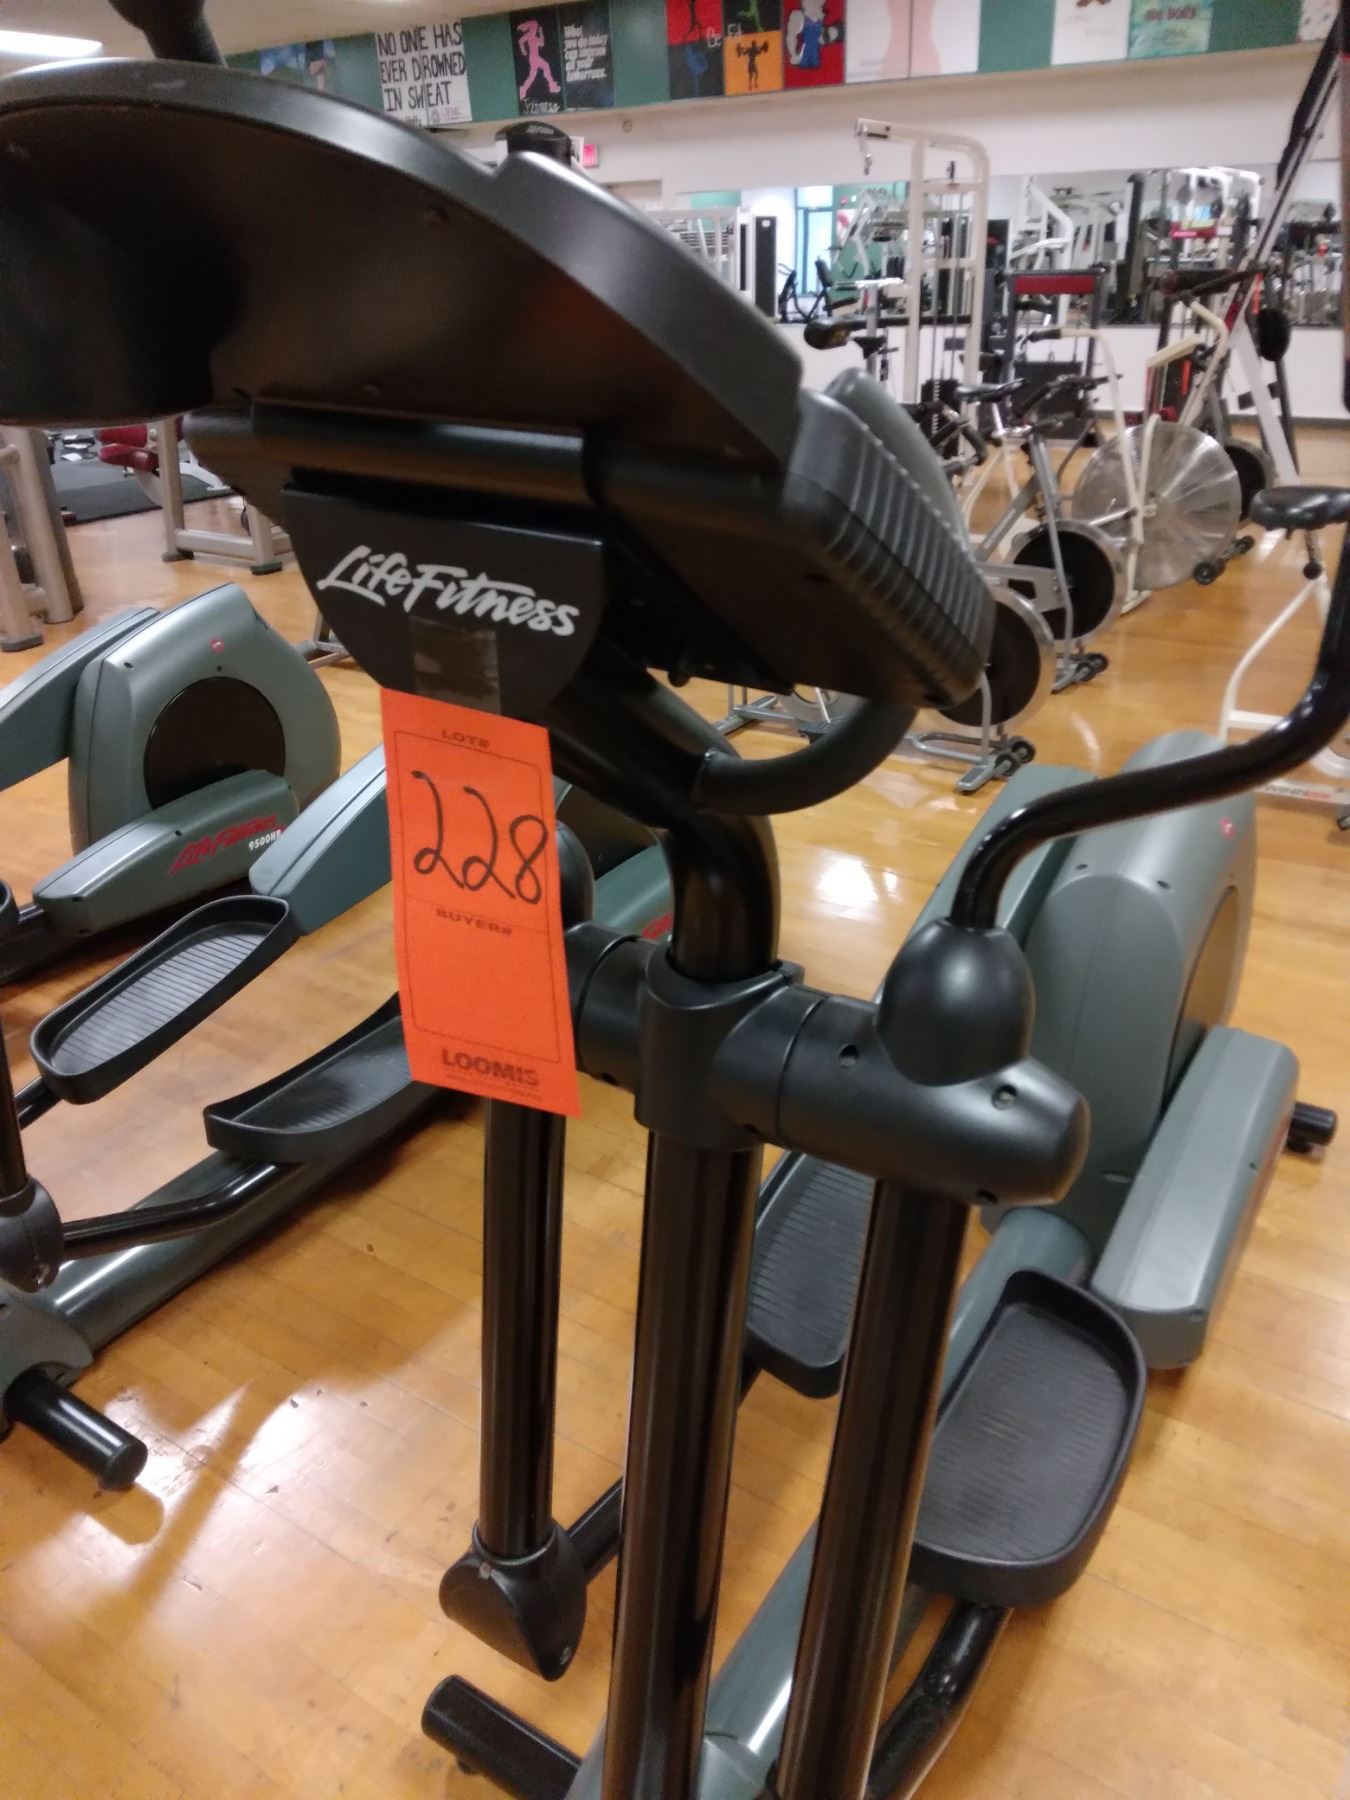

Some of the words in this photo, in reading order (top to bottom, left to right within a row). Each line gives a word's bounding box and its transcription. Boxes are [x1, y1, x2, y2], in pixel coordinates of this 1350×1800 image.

[377, 32, 397, 56] NO
[400, 25, 429, 54] ONE
[433, 22, 463, 48] HAS
[380, 59, 407, 84] EVER
[412, 51, 466, 81] DROWNED
[384, 87, 402, 111] IN
[408, 80, 452, 109] SWEAT
[411, 770, 548, 905] 228
[441, 1049, 540, 1087] LOOMIS
